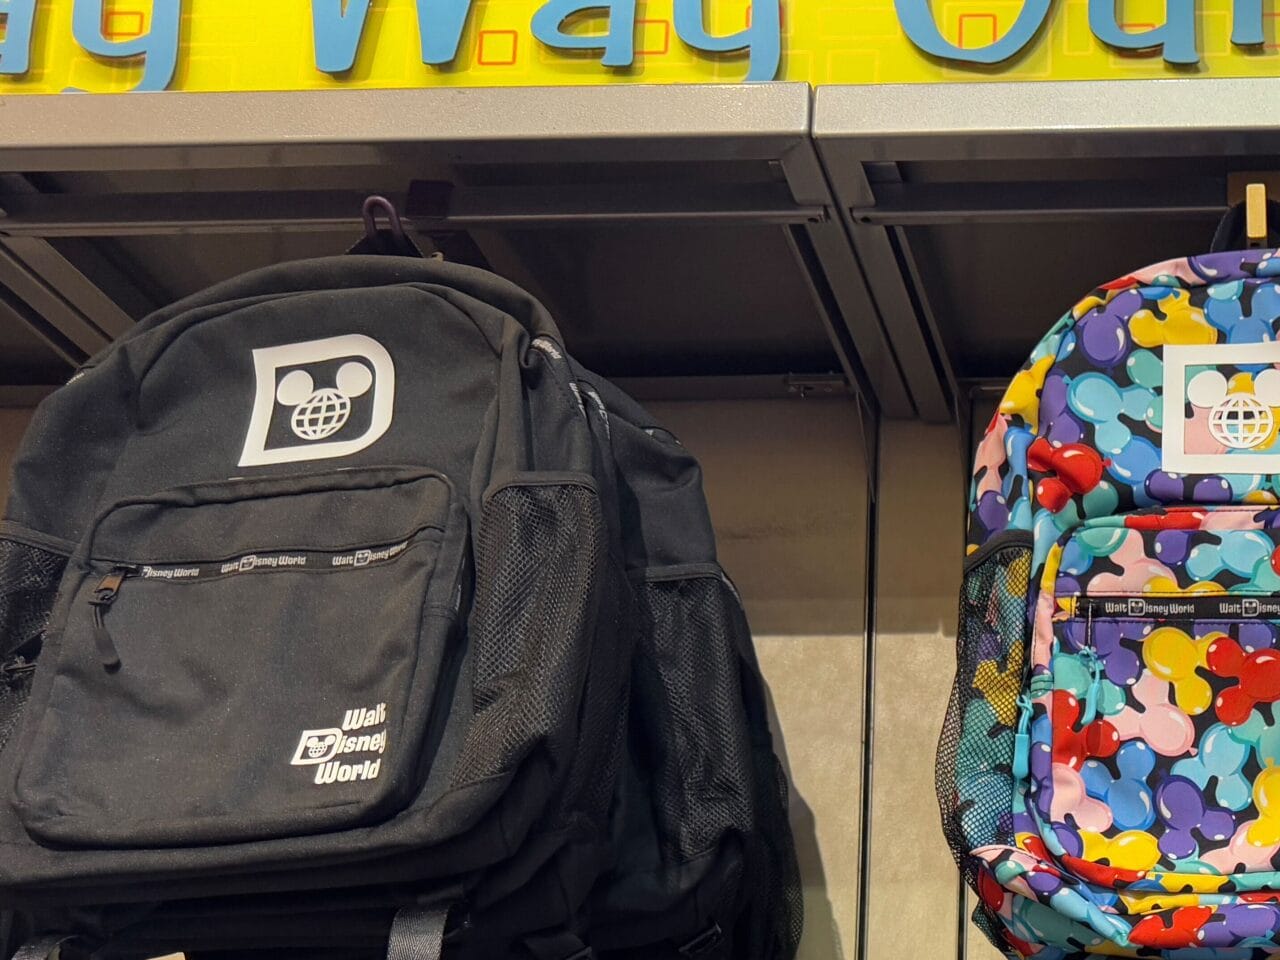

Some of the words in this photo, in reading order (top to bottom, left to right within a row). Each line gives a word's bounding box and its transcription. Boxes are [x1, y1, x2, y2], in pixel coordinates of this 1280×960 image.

[221, 562, 239, 574] Walt
[239, 554, 278, 572] Disney
[278, 555, 306, 567] World
[332, 555, 354, 566] Walt
[173, 567, 200, 578] World
[1105, 602, 1128, 614] Walt
[1127, 598, 1169, 616] Disney
[1169, 602, 1195, 615] World
[1219, 602, 1242, 614] Walt
[342, 702, 387, 731] Walt
[290, 727, 387, 765] Disney
[314, 758, 382, 785] World
